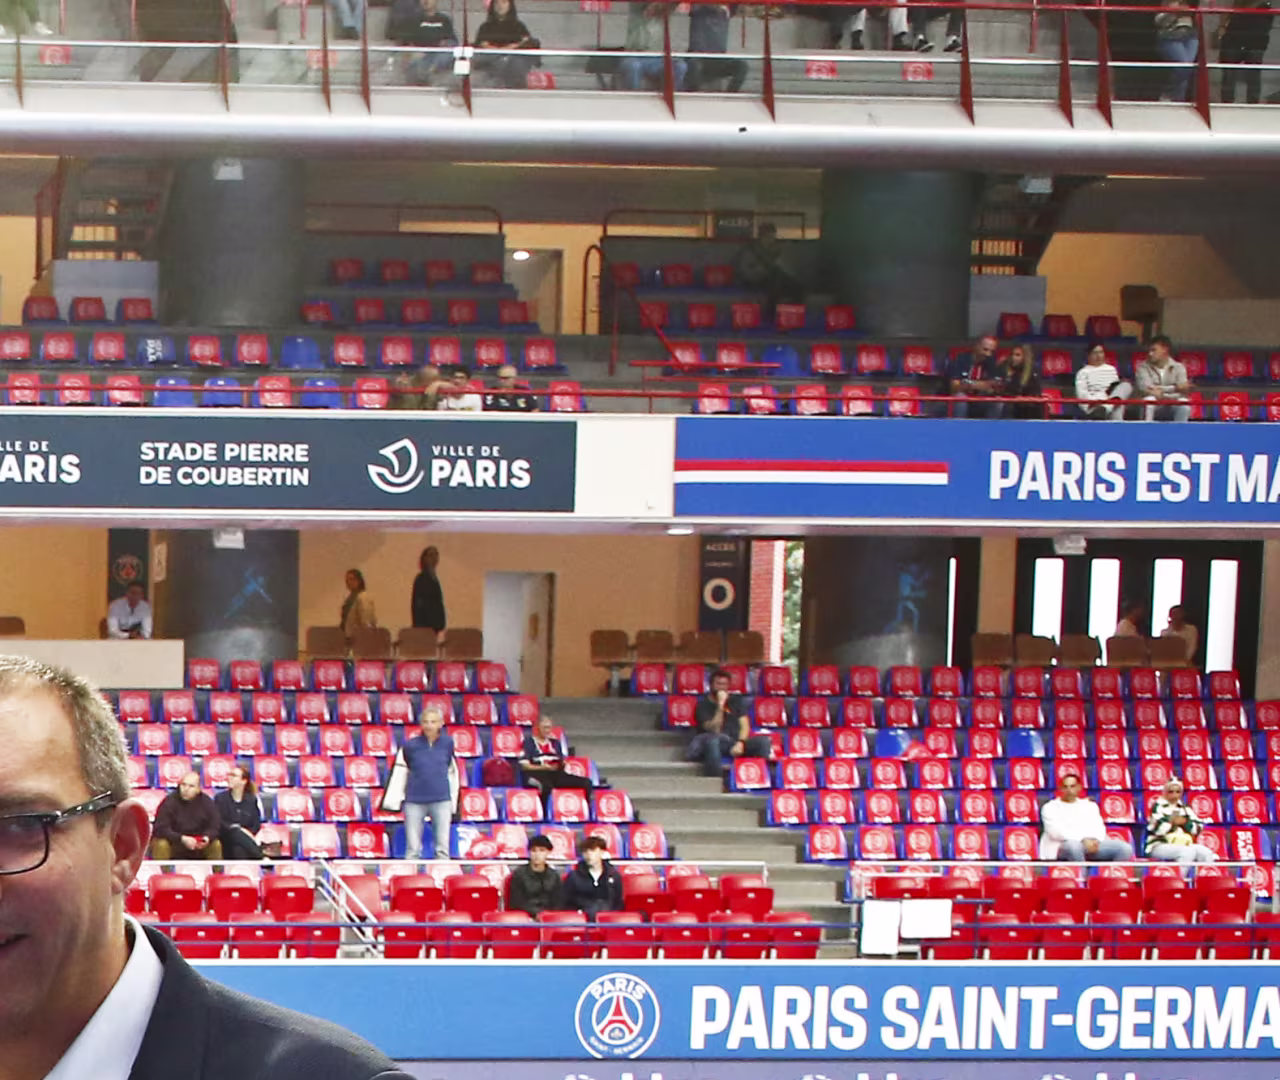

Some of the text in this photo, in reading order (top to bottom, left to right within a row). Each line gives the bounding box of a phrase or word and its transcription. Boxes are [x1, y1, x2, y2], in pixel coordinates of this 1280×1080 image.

[29, 440, 49, 452] DE
[140, 442, 309, 462] STADE PIERRE
[431, 445, 500, 457] VILLE DE
[140, 466, 309, 486] DE COUBERTIN
[431, 459, 531, 488] PARIS
[989, 451, 1126, 503] PARIS
[1136, 452, 1221, 503] EST
[589, 977, 646, 1000] PARIS
[690, 985, 1280, 1051] PARIS SAINT-GERMA
